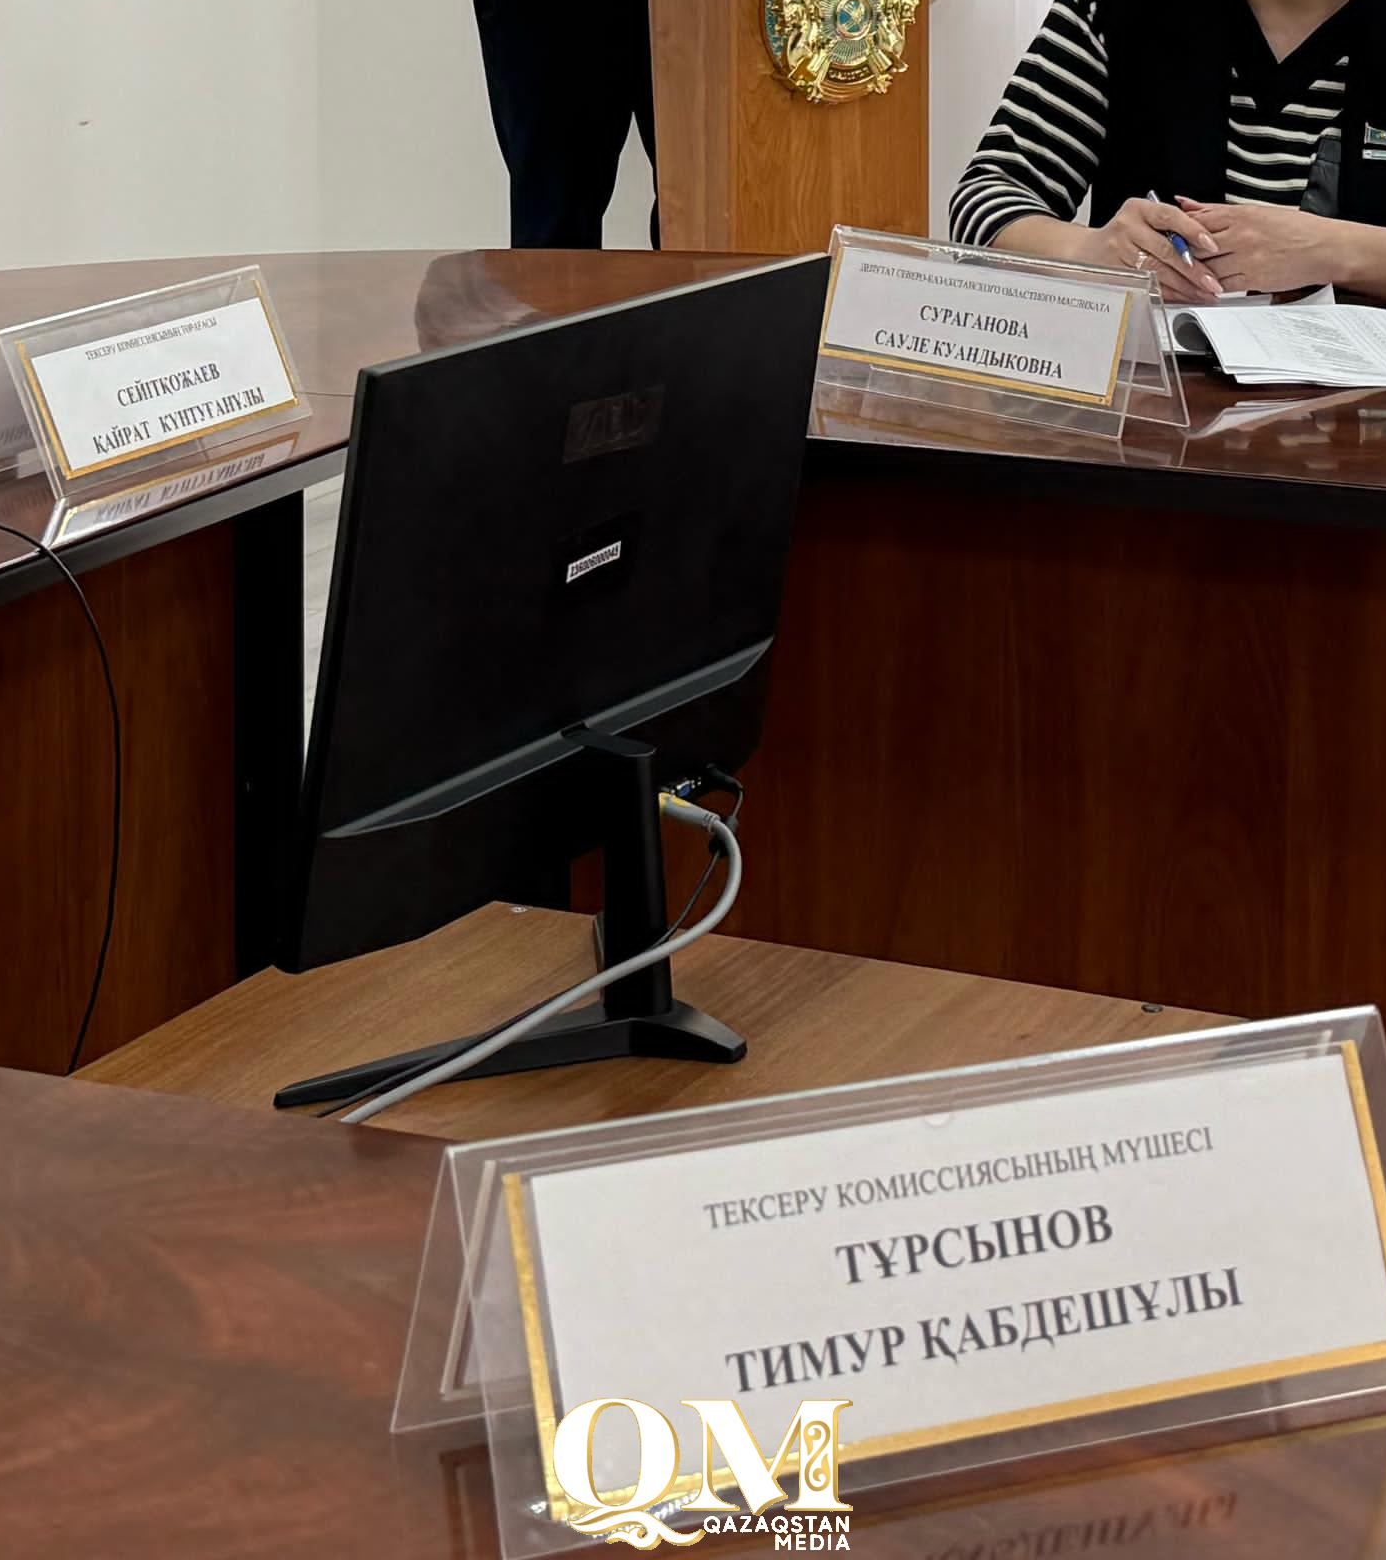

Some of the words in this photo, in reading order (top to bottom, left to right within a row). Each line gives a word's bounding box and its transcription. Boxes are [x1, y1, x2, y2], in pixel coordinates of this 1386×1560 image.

[875, 329, 929, 355] САУЛЕ
[933, 339, 1063, 379] КУАНДЫКОВНА
[919, 304, 1029, 339] СУРАГАНОВА
[703, 1186, 827, 1230] ТЕКСЕРУ
[835, 1145, 1100, 1210] КОМИССИЯСЫНЫҢ
[1101, 1125, 1213, 1169] МҮШЕСІ
[834, 1203, 1114, 1286] ТҰРСЫНОВ
[724, 1320, 907, 1395] ТИМУР
[919, 1264, 1244, 1363] ҚАБДЕШҰЛЫ
